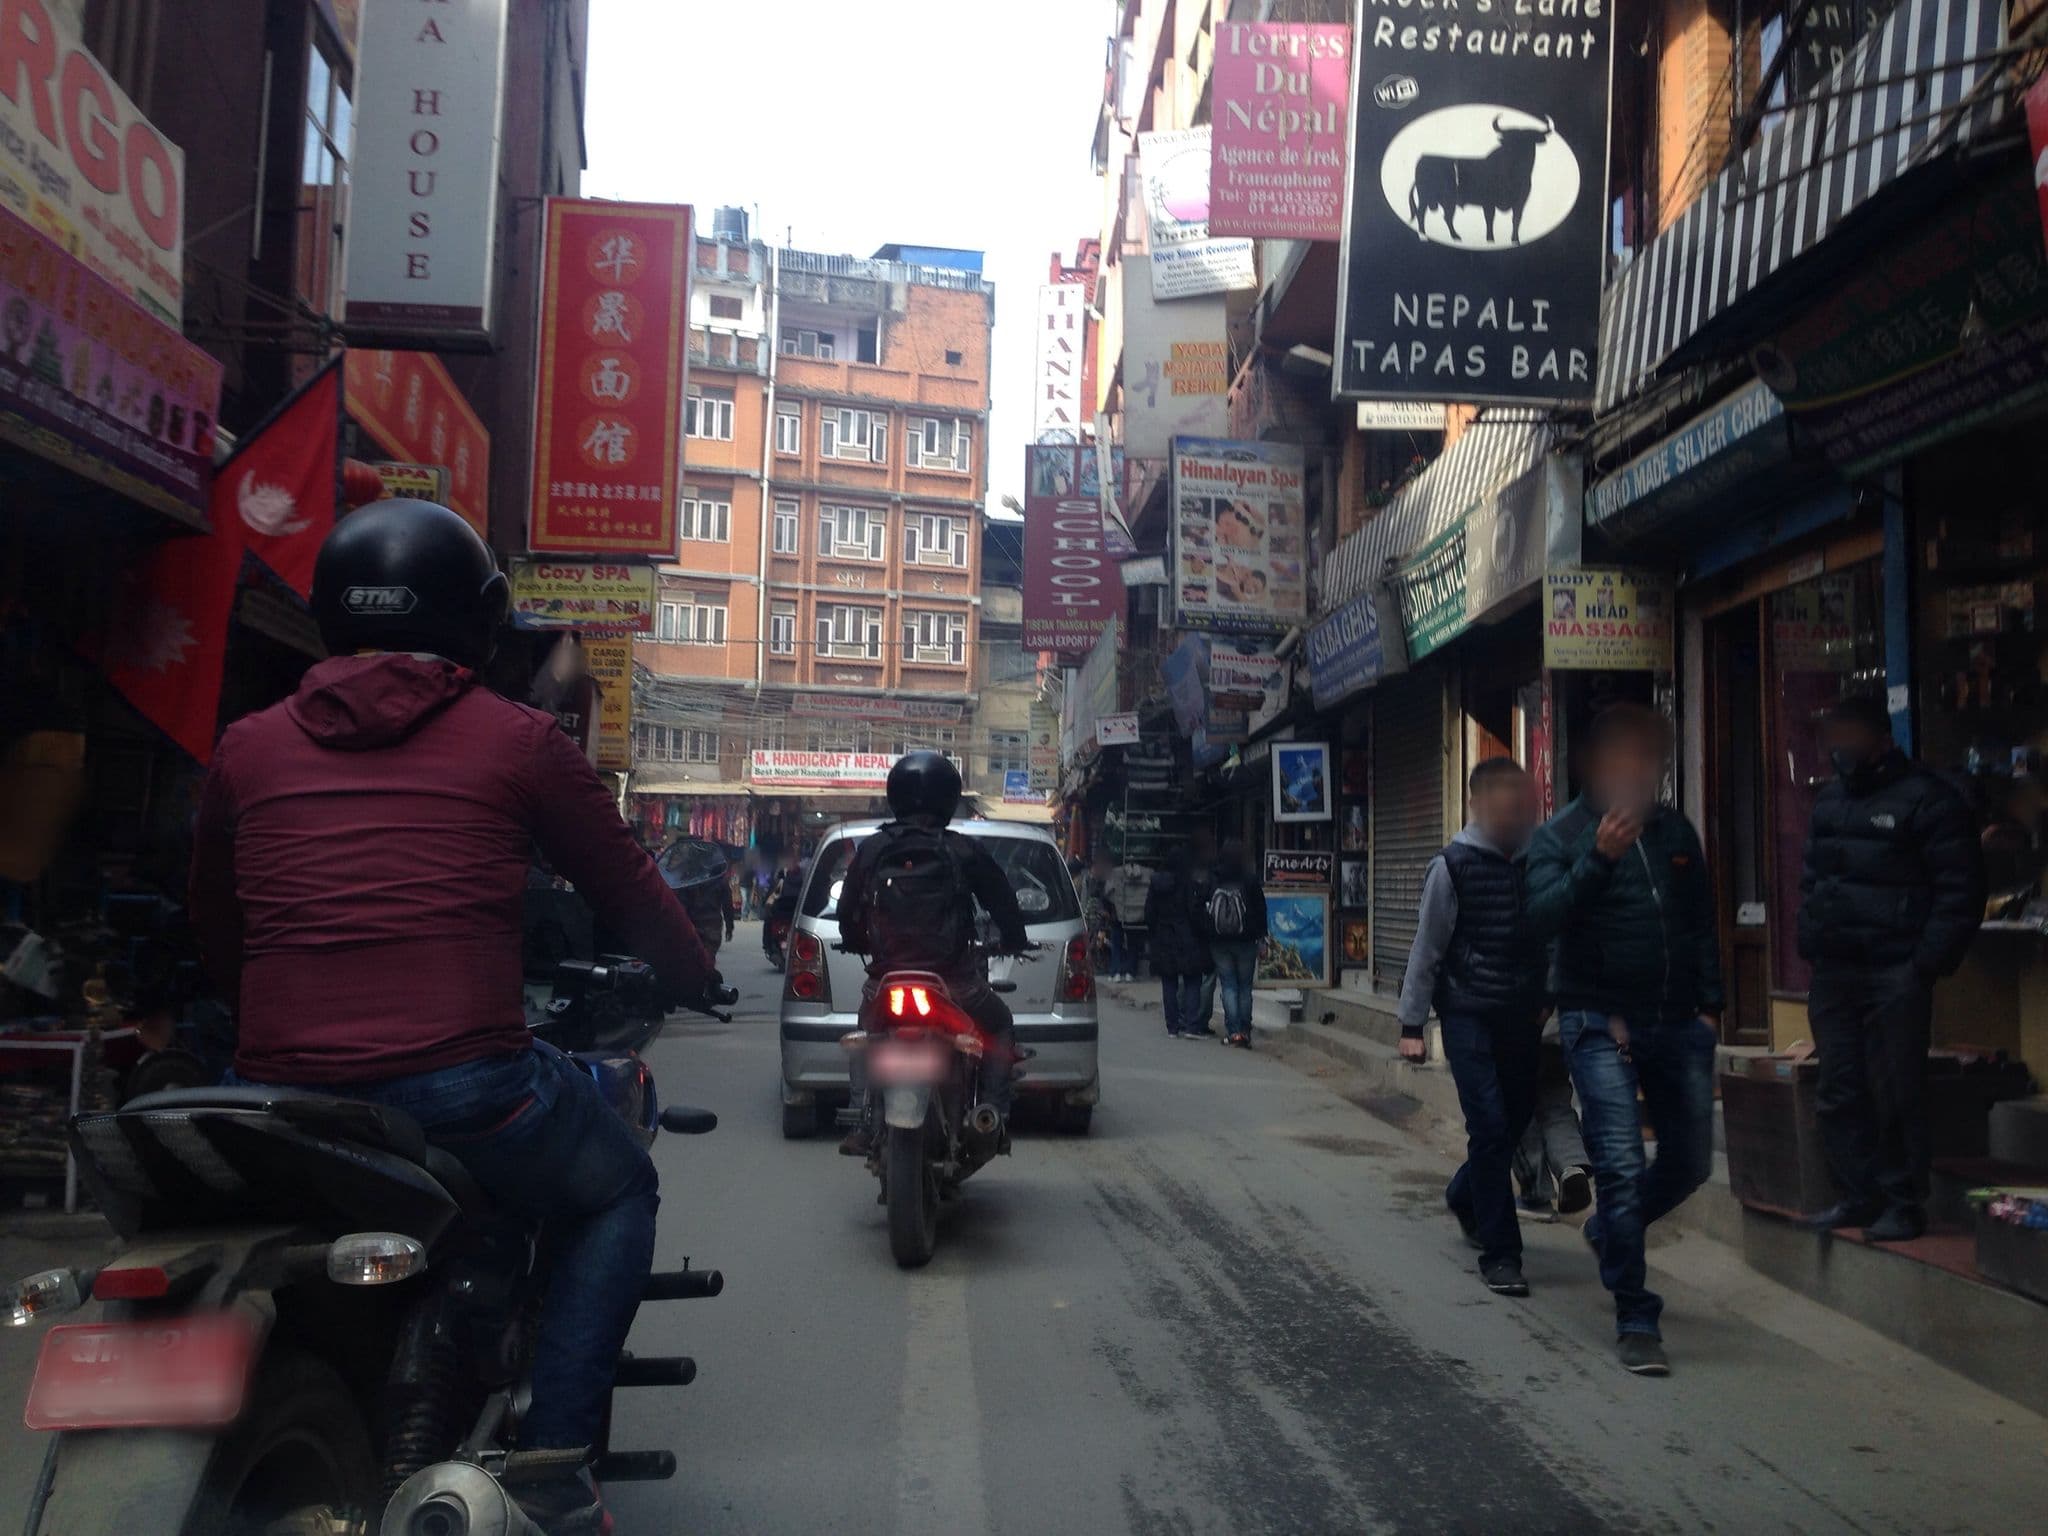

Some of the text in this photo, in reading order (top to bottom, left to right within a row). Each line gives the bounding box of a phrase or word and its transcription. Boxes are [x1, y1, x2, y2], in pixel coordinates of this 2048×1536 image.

[1222, 24, 1345, 58] Terres
[1374, 16, 1595, 59] Restaurant
[1256, 63, 1310, 96] Du
[1225, 100, 1337, 142] Népal
[1218, 144, 1275, 168] Agence
[1280, 147, 1300, 166] de
[1303, 148, 1341, 168] Trek
[406, 89, 440, 281] HOUSE
[1228, 170, 1332, 190] Francophone
[1393, 292, 1550, 332] NEPALI
[1045, 289, 1075, 425] THANKA
[1352, 339, 1588, 382] TAPAS BAR
[1633, 450, 1671, 497] MADE
[1675, 415, 1728, 474] SILVER
[1731, 386, 1776, 439] CRAF
[1181, 459, 1299, 492] Himalayan Spa
[1050, 500, 1102, 606] SCHOOL
[537, 564, 631, 582] Cozy SPA
[1548, 575, 1594, 586] BODY
[1342, 593, 1377, 648] GEMS
[1586, 604, 1628, 618] HEAD
[1055, 636, 1088, 648] EXPORT
[1548, 621, 1666, 636] MASSAGE
[593, 648, 625, 657] CARGO
[755, 752, 893, 769] M. HANDICRAFT NEPAL
[801, 769, 841, 777] Handicraft
[1267, 854, 1330, 871] Fine Arts
